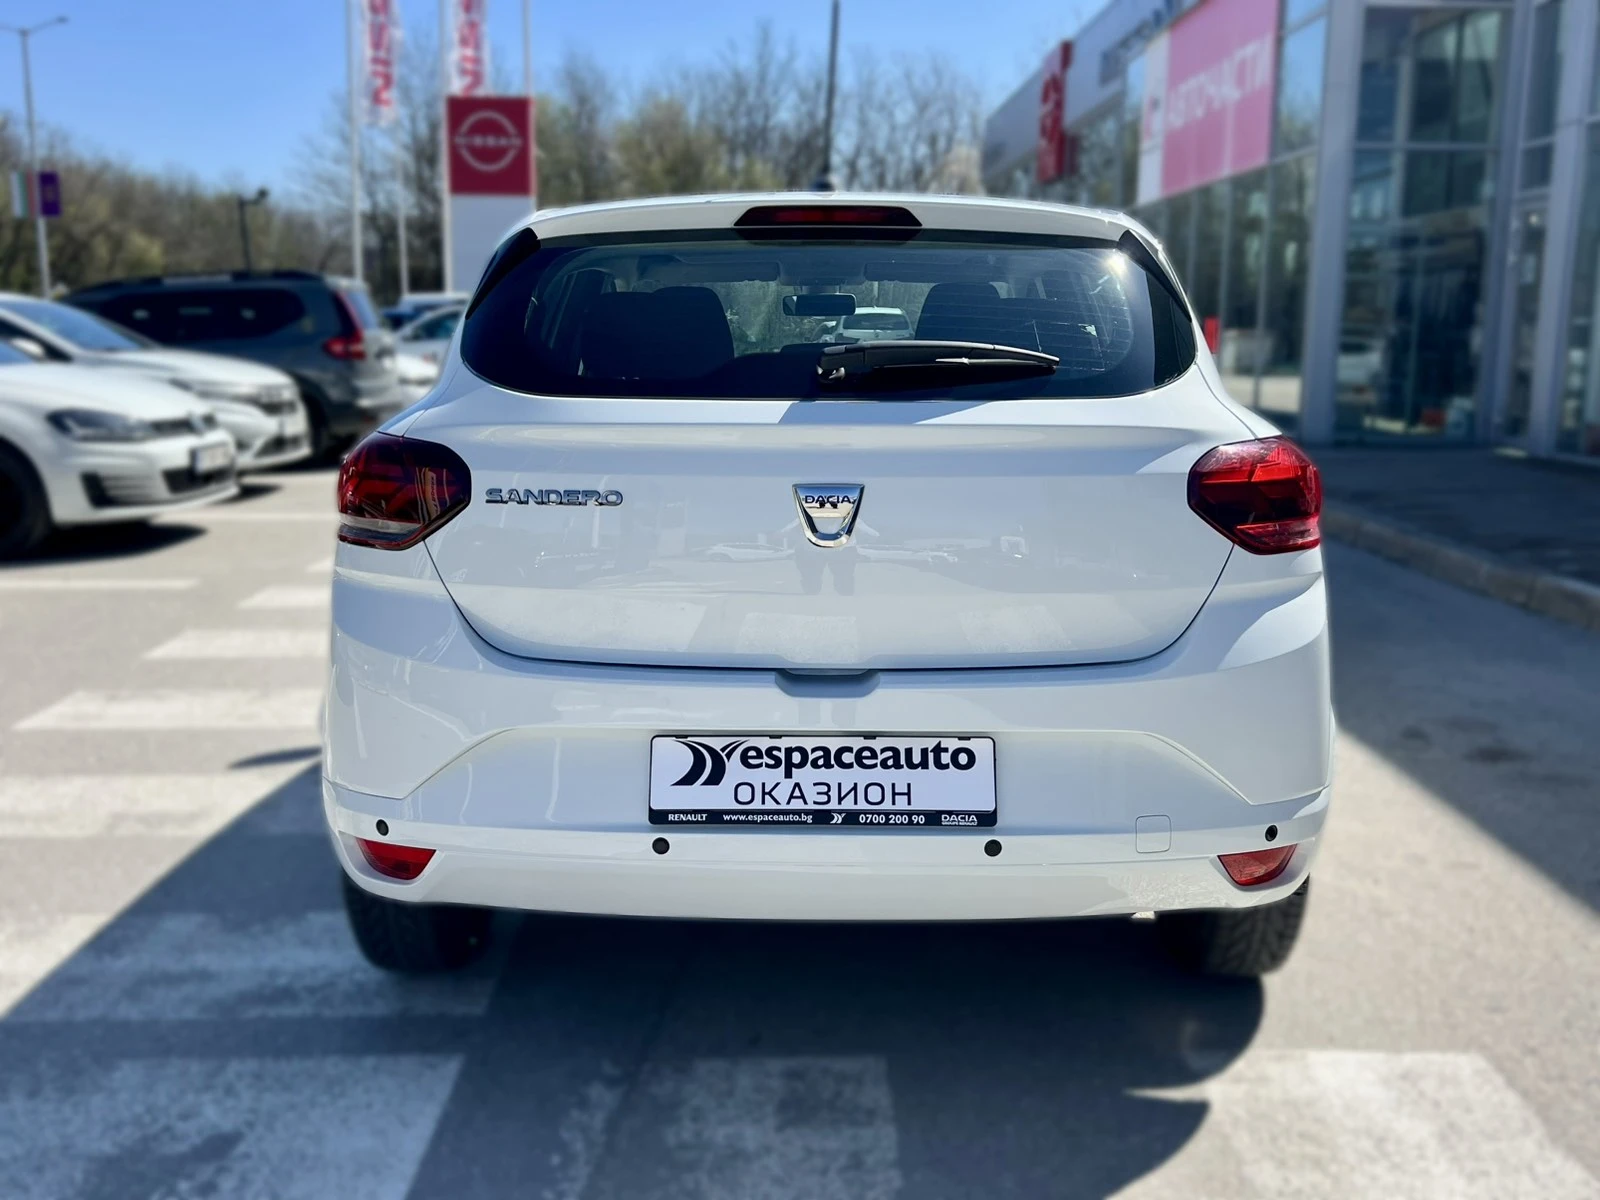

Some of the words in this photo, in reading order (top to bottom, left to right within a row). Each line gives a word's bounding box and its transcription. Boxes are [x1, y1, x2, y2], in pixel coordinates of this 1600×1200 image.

[485, 488, 623, 506] SANDERO
[804, 495, 851, 504] DACIA
[739, 740, 976, 779] espaceauto
[733, 782, 912, 806] ОКАЗИОН
[668, 813, 707, 821] RENAULT
[723, 813, 813, 823] www.espaceauto.bg
[859, 814, 886, 823] 0700
[888, 814, 909, 824] 200
[911, 814, 925, 824] 90
[941, 814, 977, 822] DACIA
